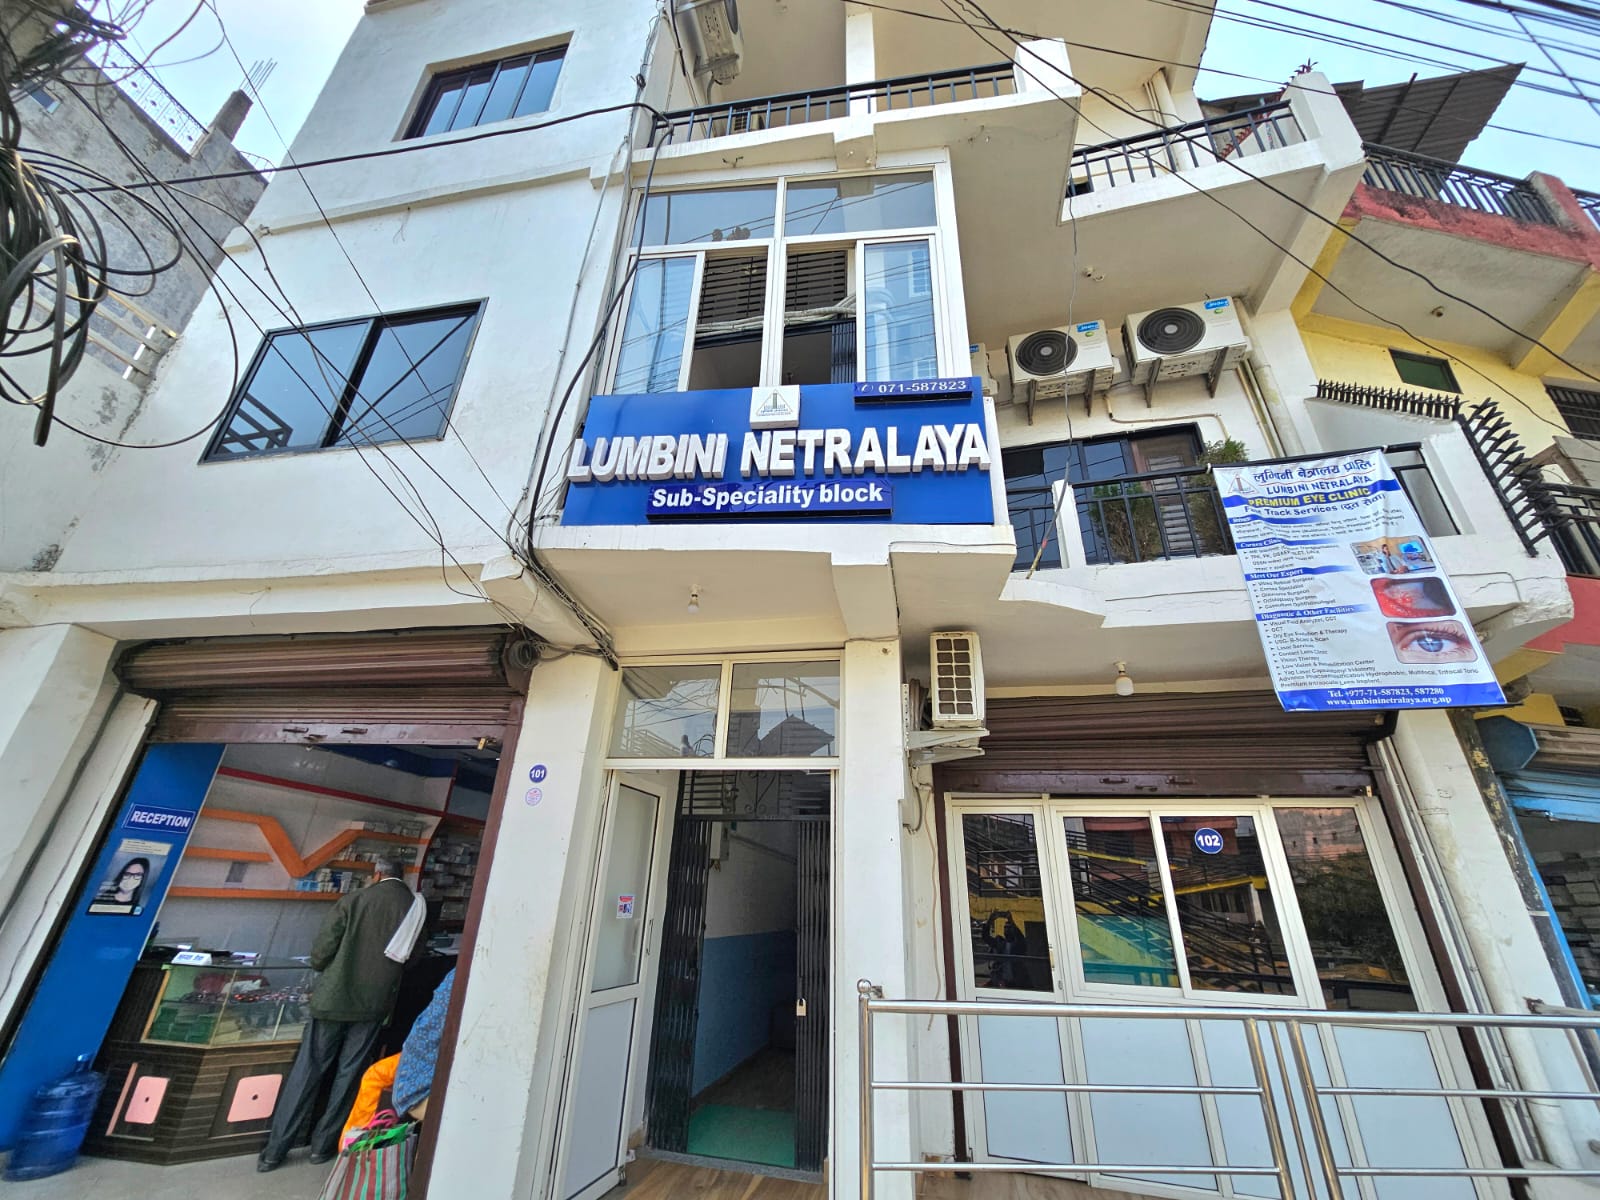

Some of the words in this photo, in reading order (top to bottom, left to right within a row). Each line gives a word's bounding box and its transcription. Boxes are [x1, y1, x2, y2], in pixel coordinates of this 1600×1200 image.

[877, 380, 967, 394] 071-587823
[568, 432, 728, 482] LUMBINI
[740, 424, 991, 478] NETRALAYA
[1267, 485, 1309, 495] LUMBINI
[1312, 475, 1372, 490] NETRALAYA
[652, 485, 812, 509] Sub-Speciality
[819, 482, 883, 503] block
[1248, 495, 1300, 507] PREMIUM
[1302, 494, 1325, 504] EYE
[1328, 488, 1371, 500] CLINIC
[1264, 508, 1291, 516] Track
[1294, 504, 1338, 516] Services
[1281, 569, 1304, 578] Expert
[530, 769, 545, 778] 101
[130, 810, 192, 828] RECEPTION
[1198, 834, 1220, 847] 102
